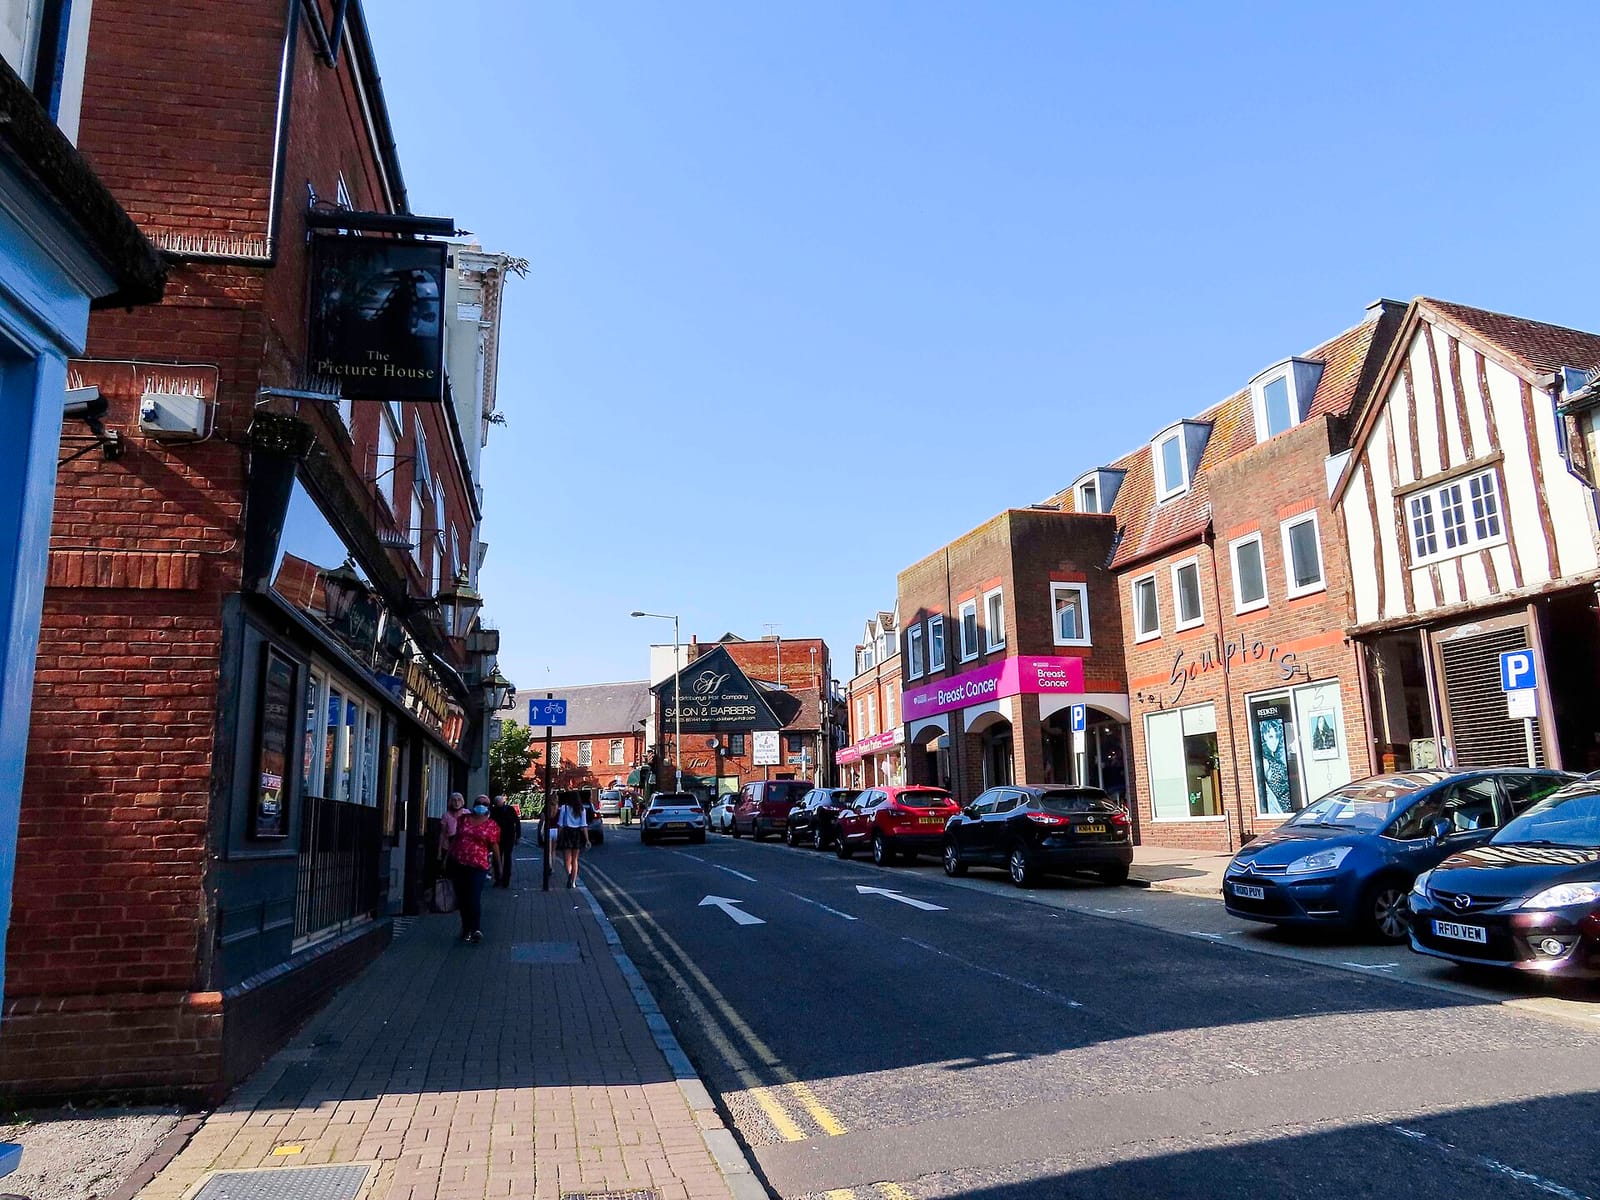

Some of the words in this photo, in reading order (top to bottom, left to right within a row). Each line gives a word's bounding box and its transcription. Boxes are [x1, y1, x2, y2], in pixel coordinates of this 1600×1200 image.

[366, 350, 390, 361] The
[318, 360, 377, 376] Picture
[384, 363, 434, 379] House
[1037, 669, 1066, 678] Breast
[1170, 633, 1297, 704] Sculptors
[1507, 654, 1529, 688] P
[938, 687, 965, 706] Breast
[965, 677, 998, 695] Cancer
[1038, 677, 1069, 688] Cancer
[664, 707, 698, 717] SALON
[701, 706, 708, 716] &
[710, 705, 757, 716] BARBERS
[1073, 706, 1084, 729] P
[1438, 922, 1459, 937] RF10
[1461, 925, 1482, 941] VEW
